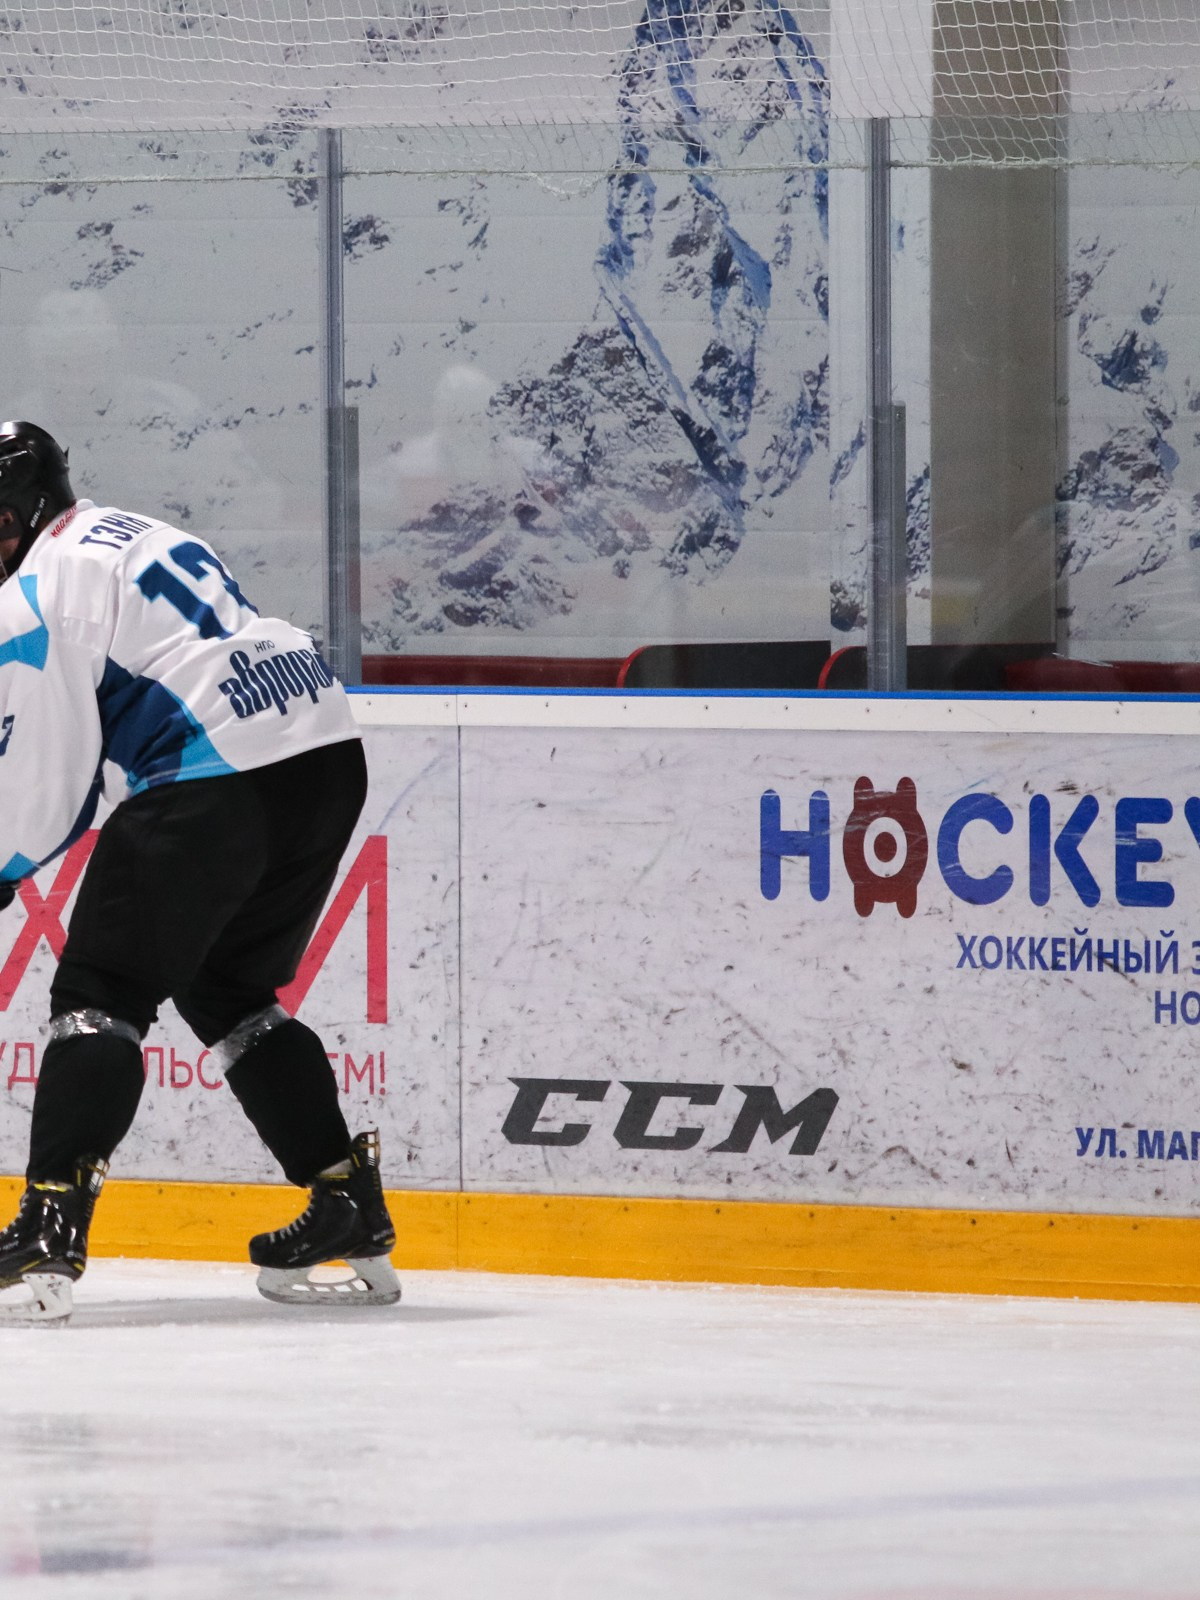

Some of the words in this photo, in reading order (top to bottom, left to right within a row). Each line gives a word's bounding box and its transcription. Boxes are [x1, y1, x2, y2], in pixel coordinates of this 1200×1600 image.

[956, 927, 1179, 975] ХОККЕЙНЫЙ
[500, 1077, 840, 1156] CCM
[1075, 1127, 1127, 1158] УЛ.
